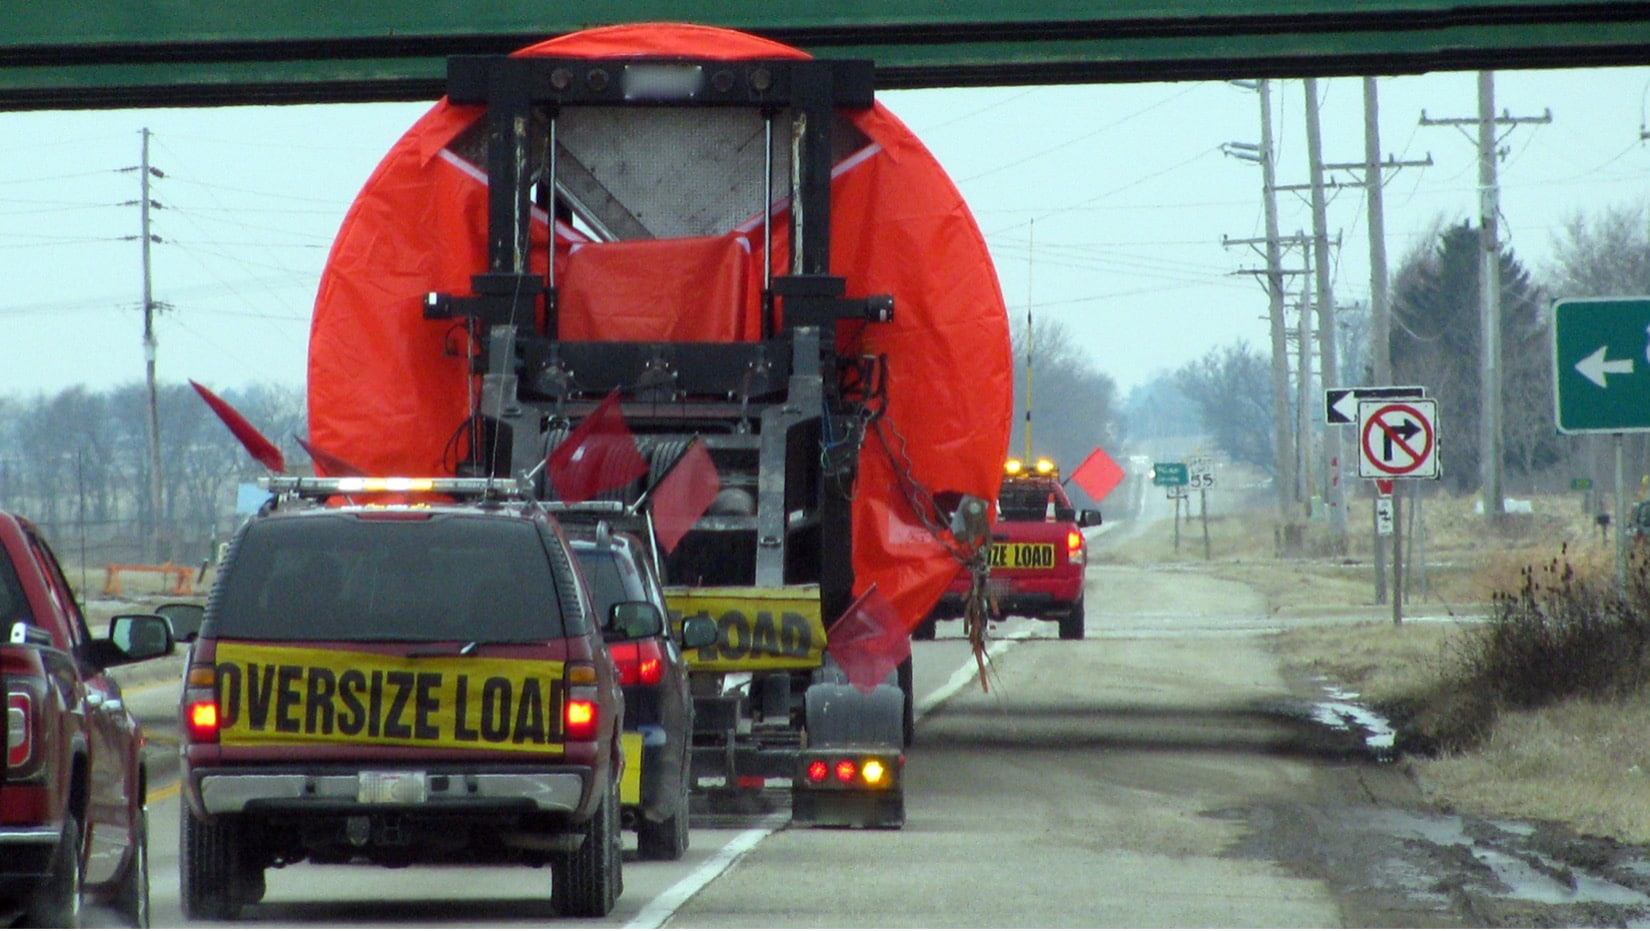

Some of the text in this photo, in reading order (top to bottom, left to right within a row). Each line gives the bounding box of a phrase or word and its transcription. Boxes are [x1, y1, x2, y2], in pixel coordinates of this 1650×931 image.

[1190, 473, 1213, 488] 55
[1014, 545, 1053, 567] LOAD
[215, 661, 442, 740] OVERSIZE
